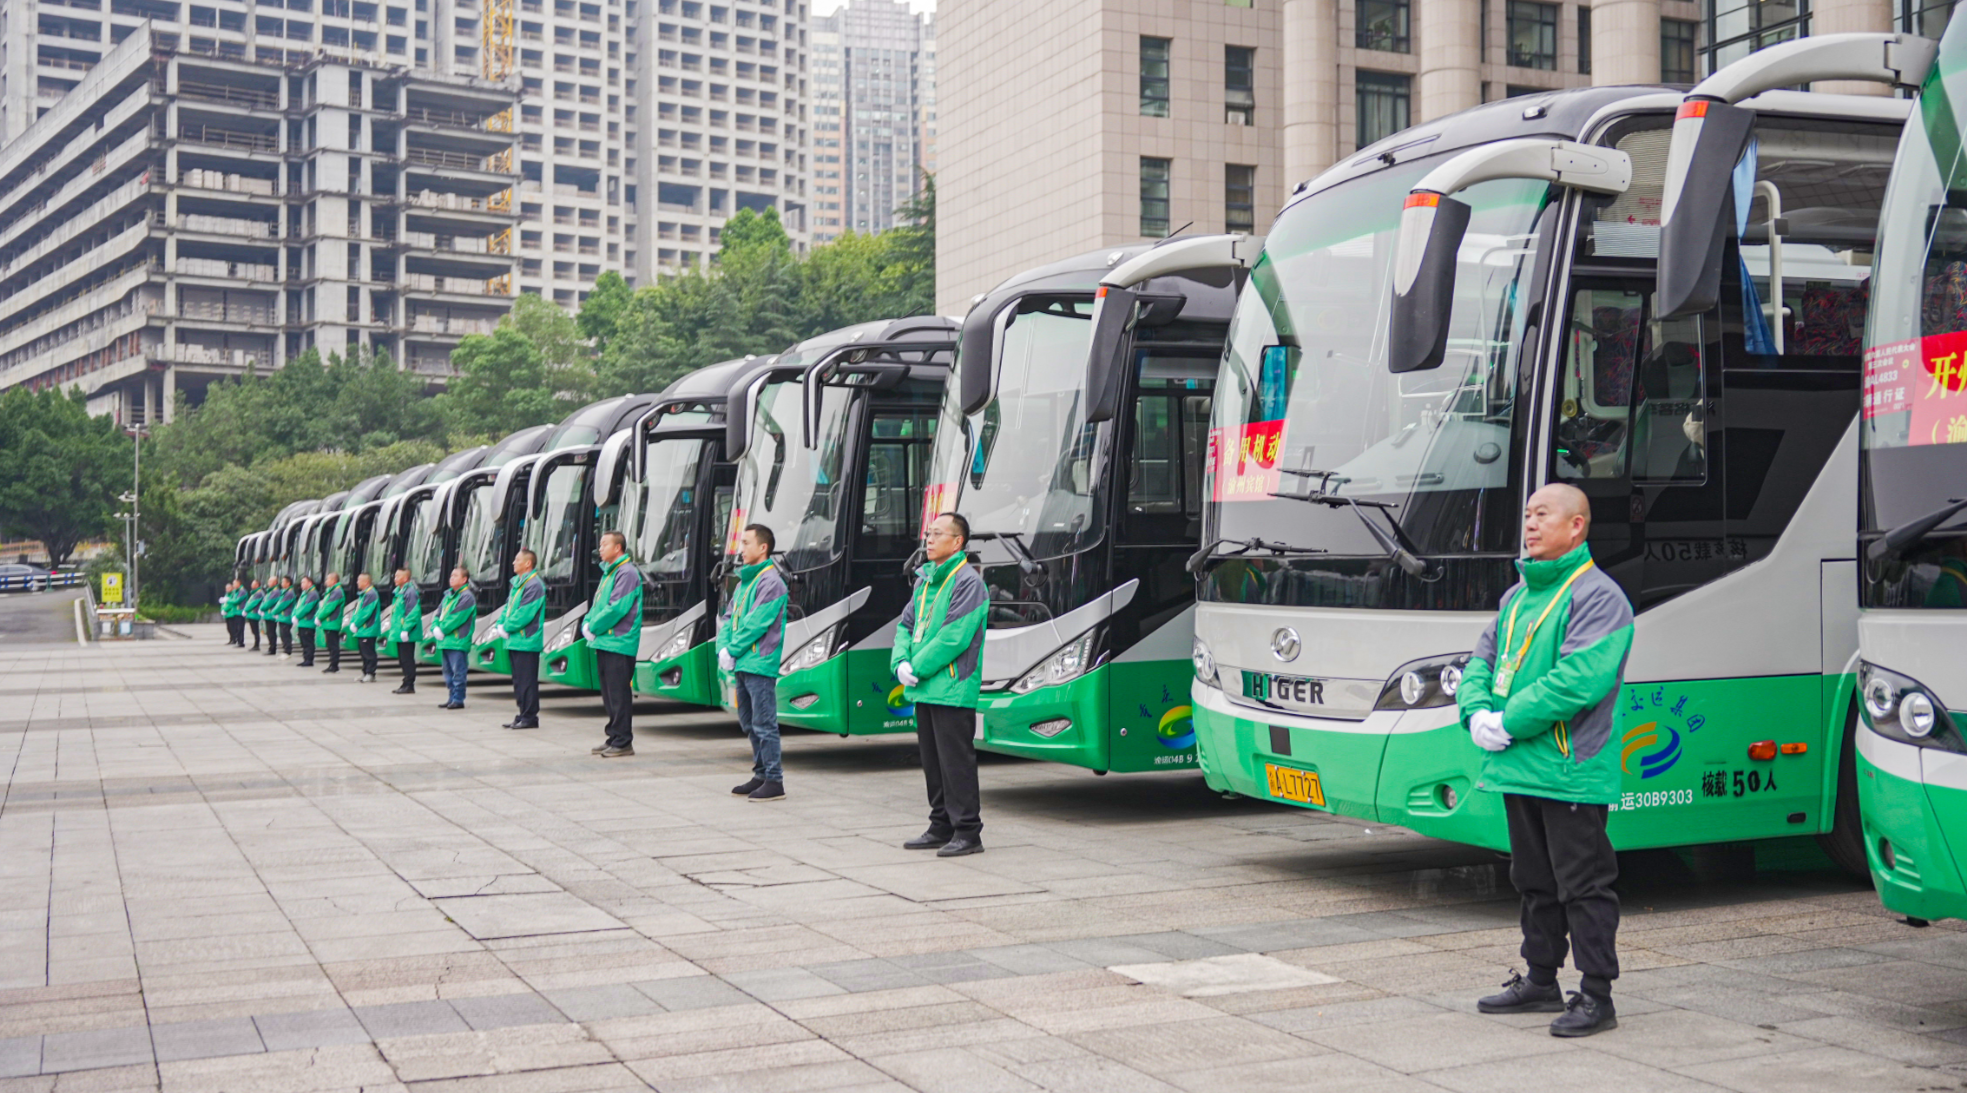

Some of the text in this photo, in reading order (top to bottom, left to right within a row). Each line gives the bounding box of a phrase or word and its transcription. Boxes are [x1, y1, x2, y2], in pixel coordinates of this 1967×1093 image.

[1223, 431, 1281, 466] 备用机动
[1252, 674, 1324, 704] HIGER
